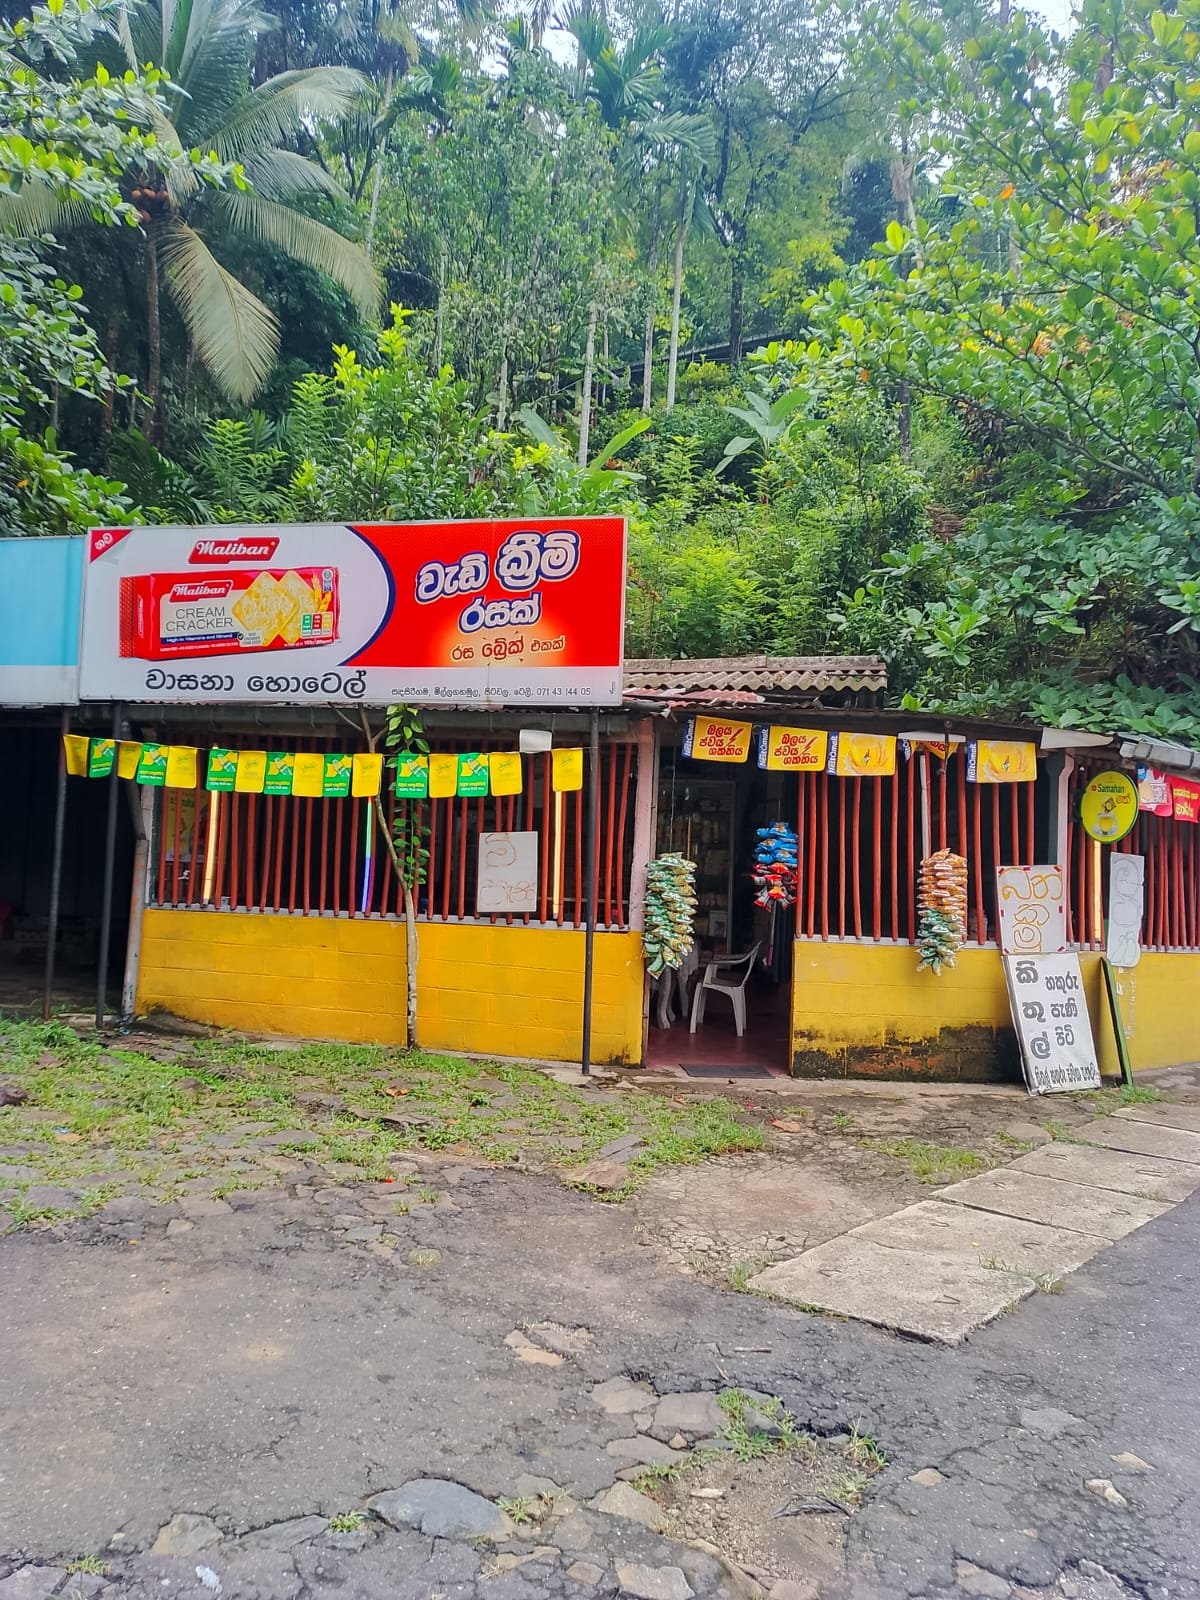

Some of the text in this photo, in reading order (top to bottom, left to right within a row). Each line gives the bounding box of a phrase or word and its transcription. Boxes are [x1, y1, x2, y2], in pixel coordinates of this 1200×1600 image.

[196, 540, 270, 556] Maliban
[416, 552, 488, 602] වැඩි
[173, 584, 226, 597] Maliban
[175, 606, 225, 619] CREAM
[460, 592, 541, 632] රසක්
[165, 617, 233, 632] CRACKER
[452, 645, 474, 660] රස
[530, 636, 565, 652] එකක්
[145, 669, 367, 699] වාසනා හොටෙල්
[536, 687, 550, 696] 071
[552, 687, 562, 696] 43
[565, 687, 578, 696] 144
[580, 687, 591, 696] 05
[707, 724, 733, 738] බලය
[782, 733, 807, 747] බලය
[1097, 783, 1125, 793] Samahan
[1045, 971, 1080, 994] හකුරු
[1050, 997, 1078, 1018] පැණි
[1054, 1024, 1075, 1047] පිටි
